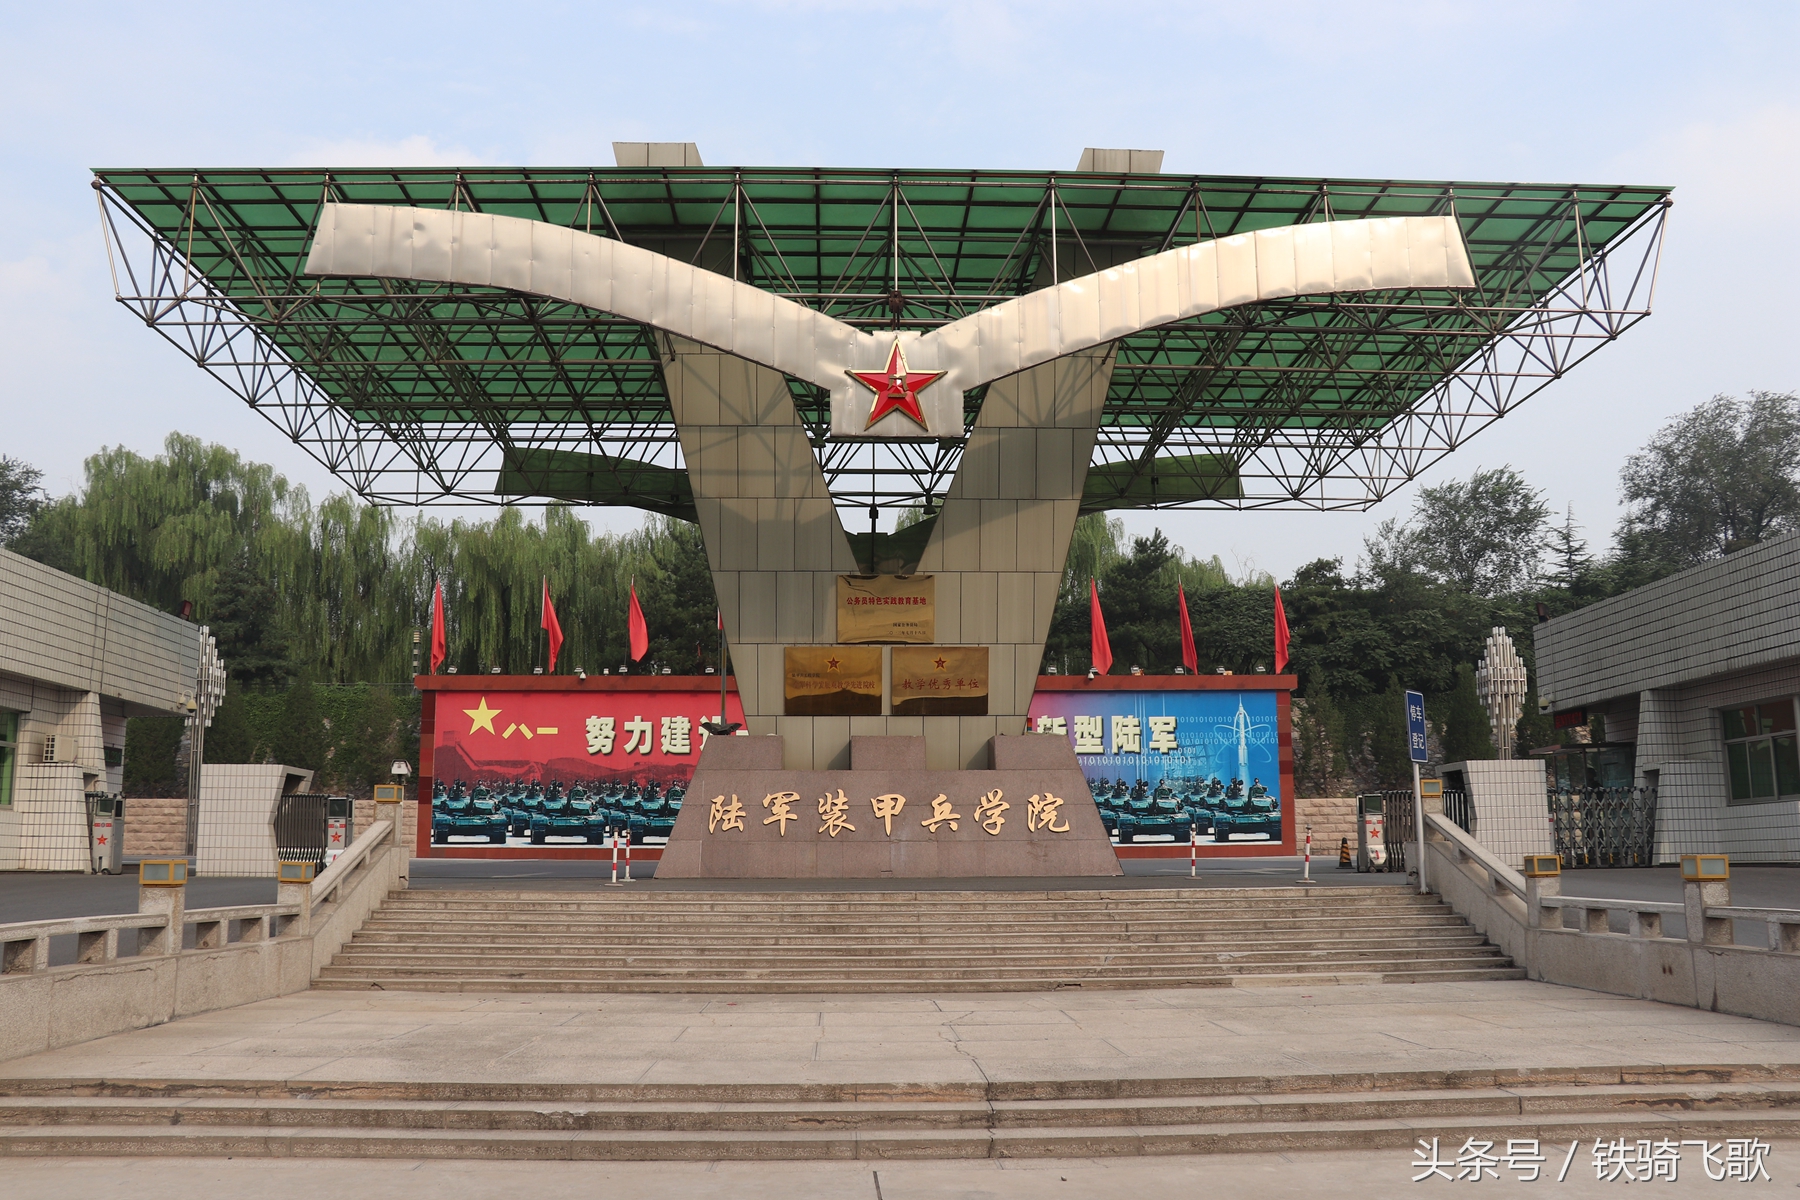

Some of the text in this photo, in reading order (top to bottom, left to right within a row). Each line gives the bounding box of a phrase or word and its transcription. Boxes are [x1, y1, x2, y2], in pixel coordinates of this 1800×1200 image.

[846, 596, 927, 606] 公务员特色实践教育基地
[902, 677, 980, 691] 教学优秀单位
[1410, 704, 1423, 722] 停车
[502, 722, 558, 740] 八一
[1412, 732, 1425, 750] 登记
[709, 789, 1070, 838] 陆军装甲兵学院
